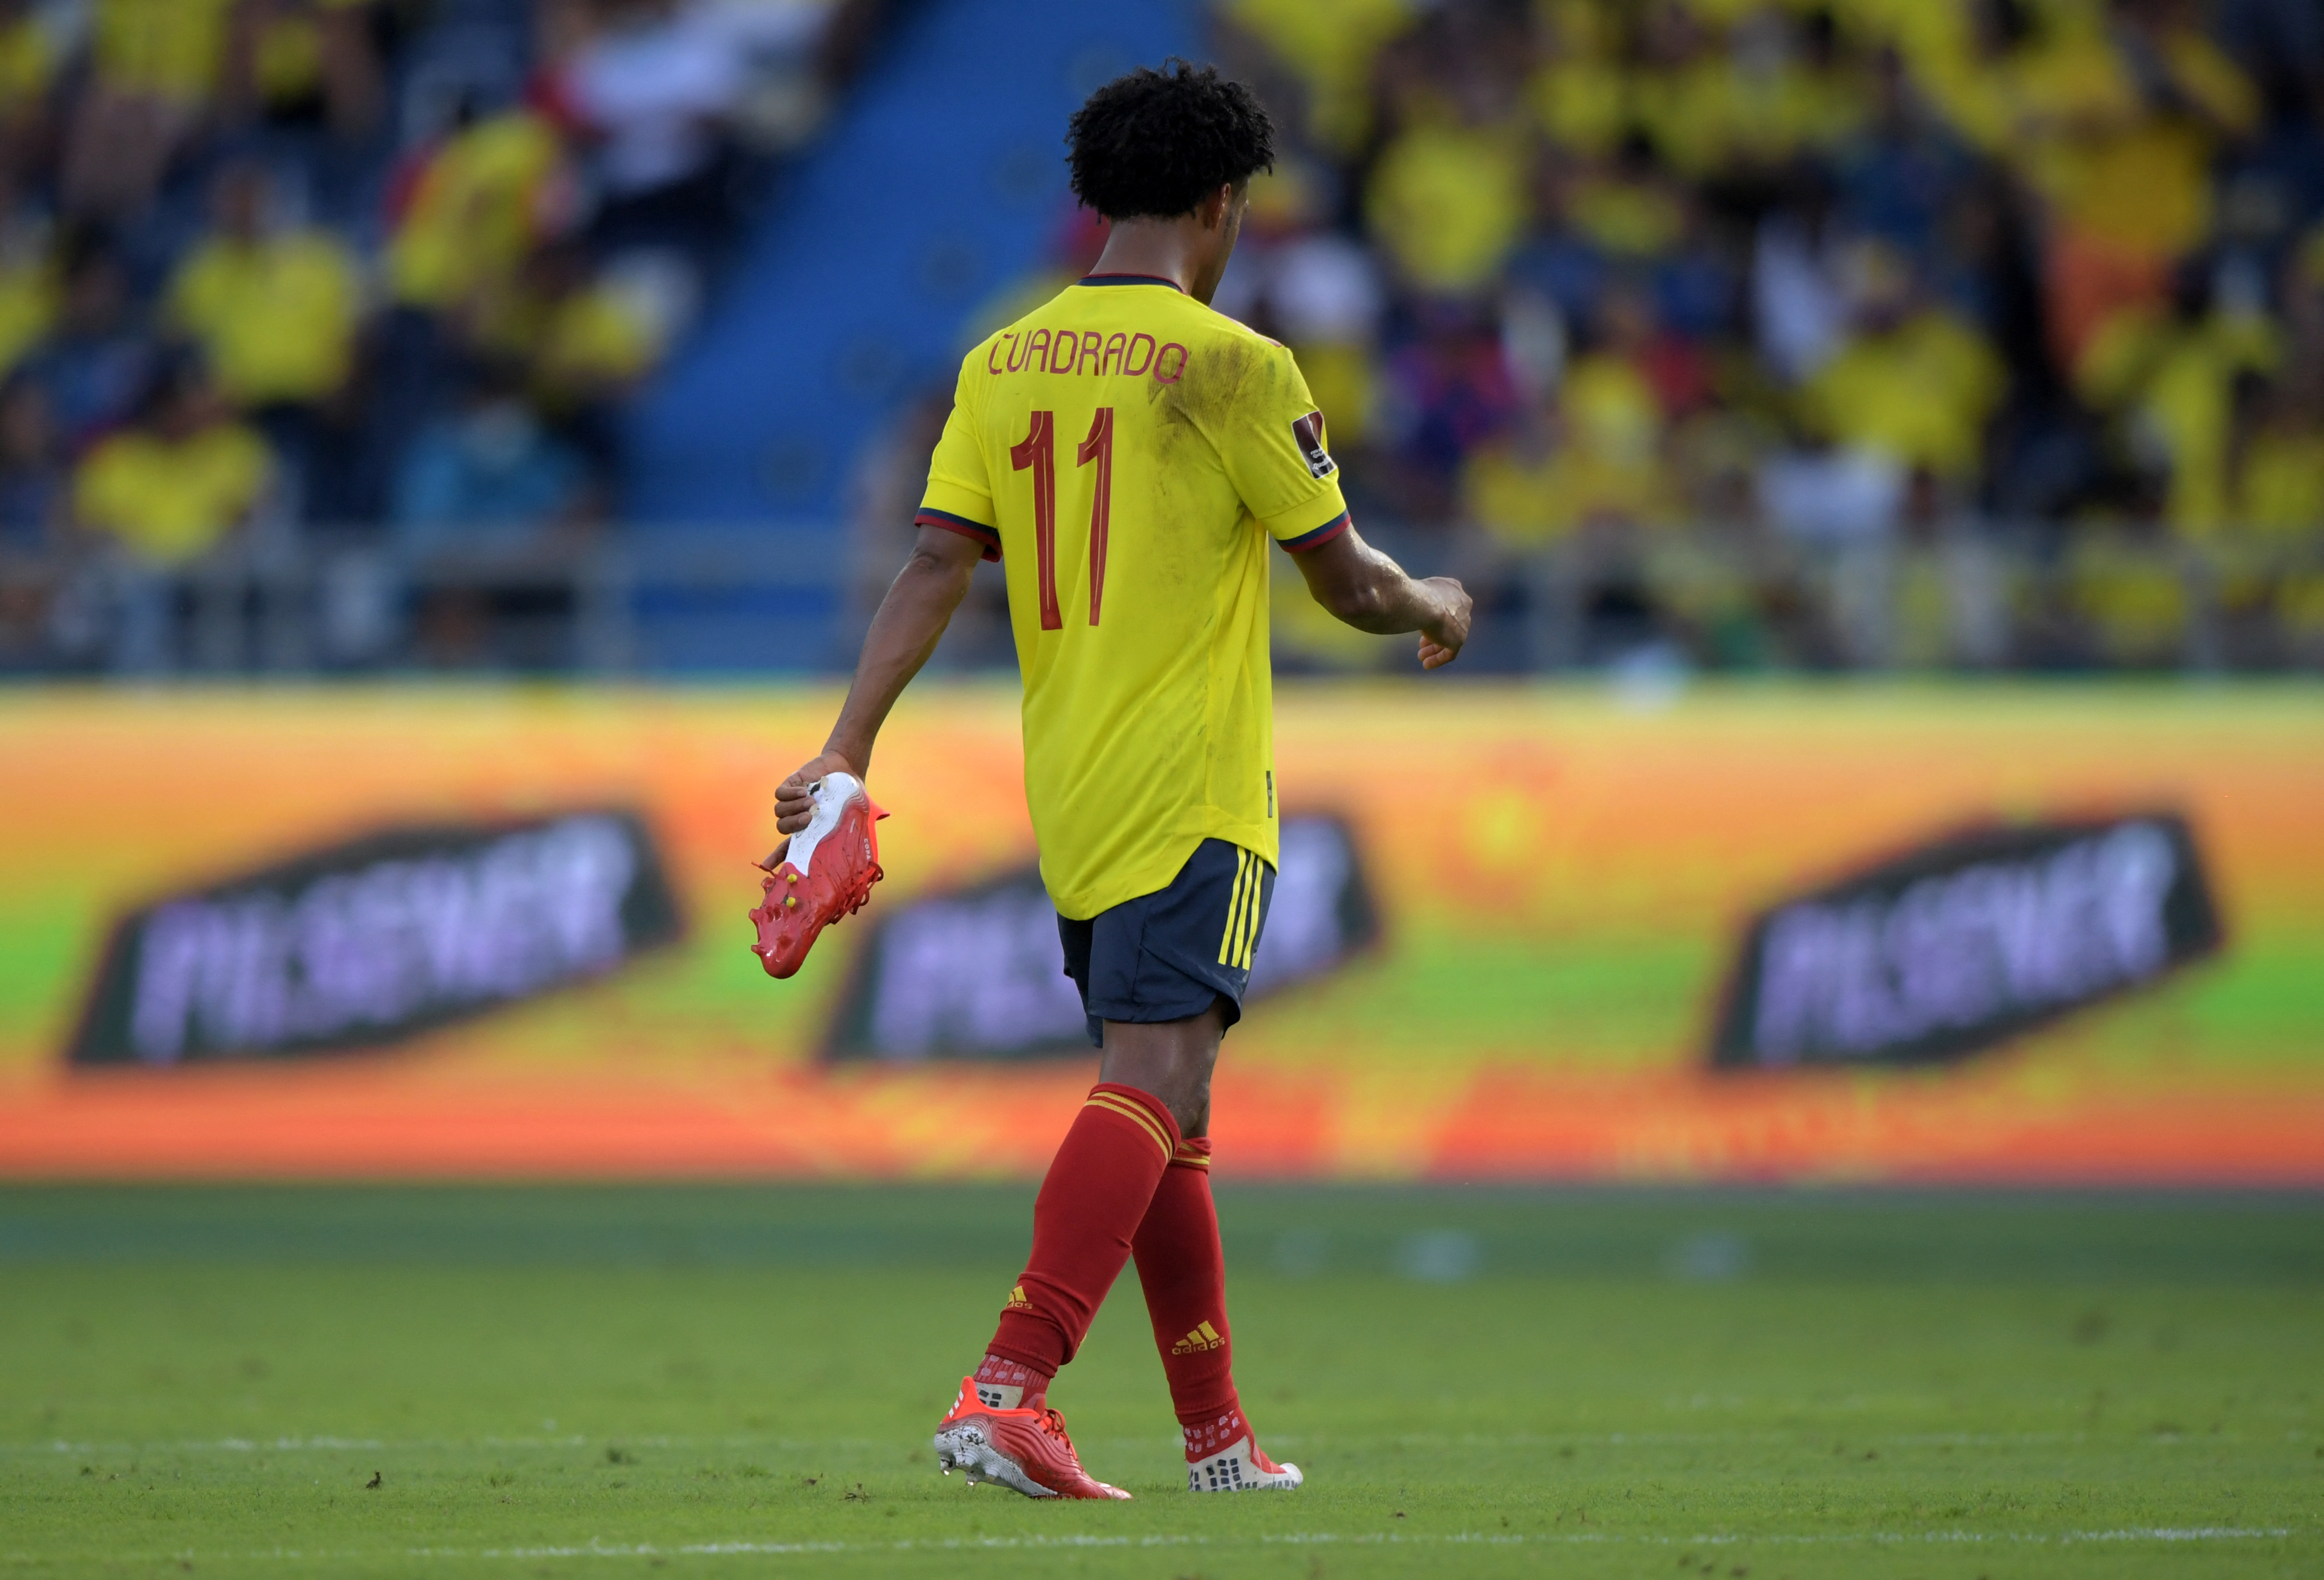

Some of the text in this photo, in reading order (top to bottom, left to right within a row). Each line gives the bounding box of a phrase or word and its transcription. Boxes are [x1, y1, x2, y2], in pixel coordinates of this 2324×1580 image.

[988, 328, 1188, 384] CUADRADO
[1010, 407, 1114, 631] 11
[1171, 1337, 1226, 1355] adidas
